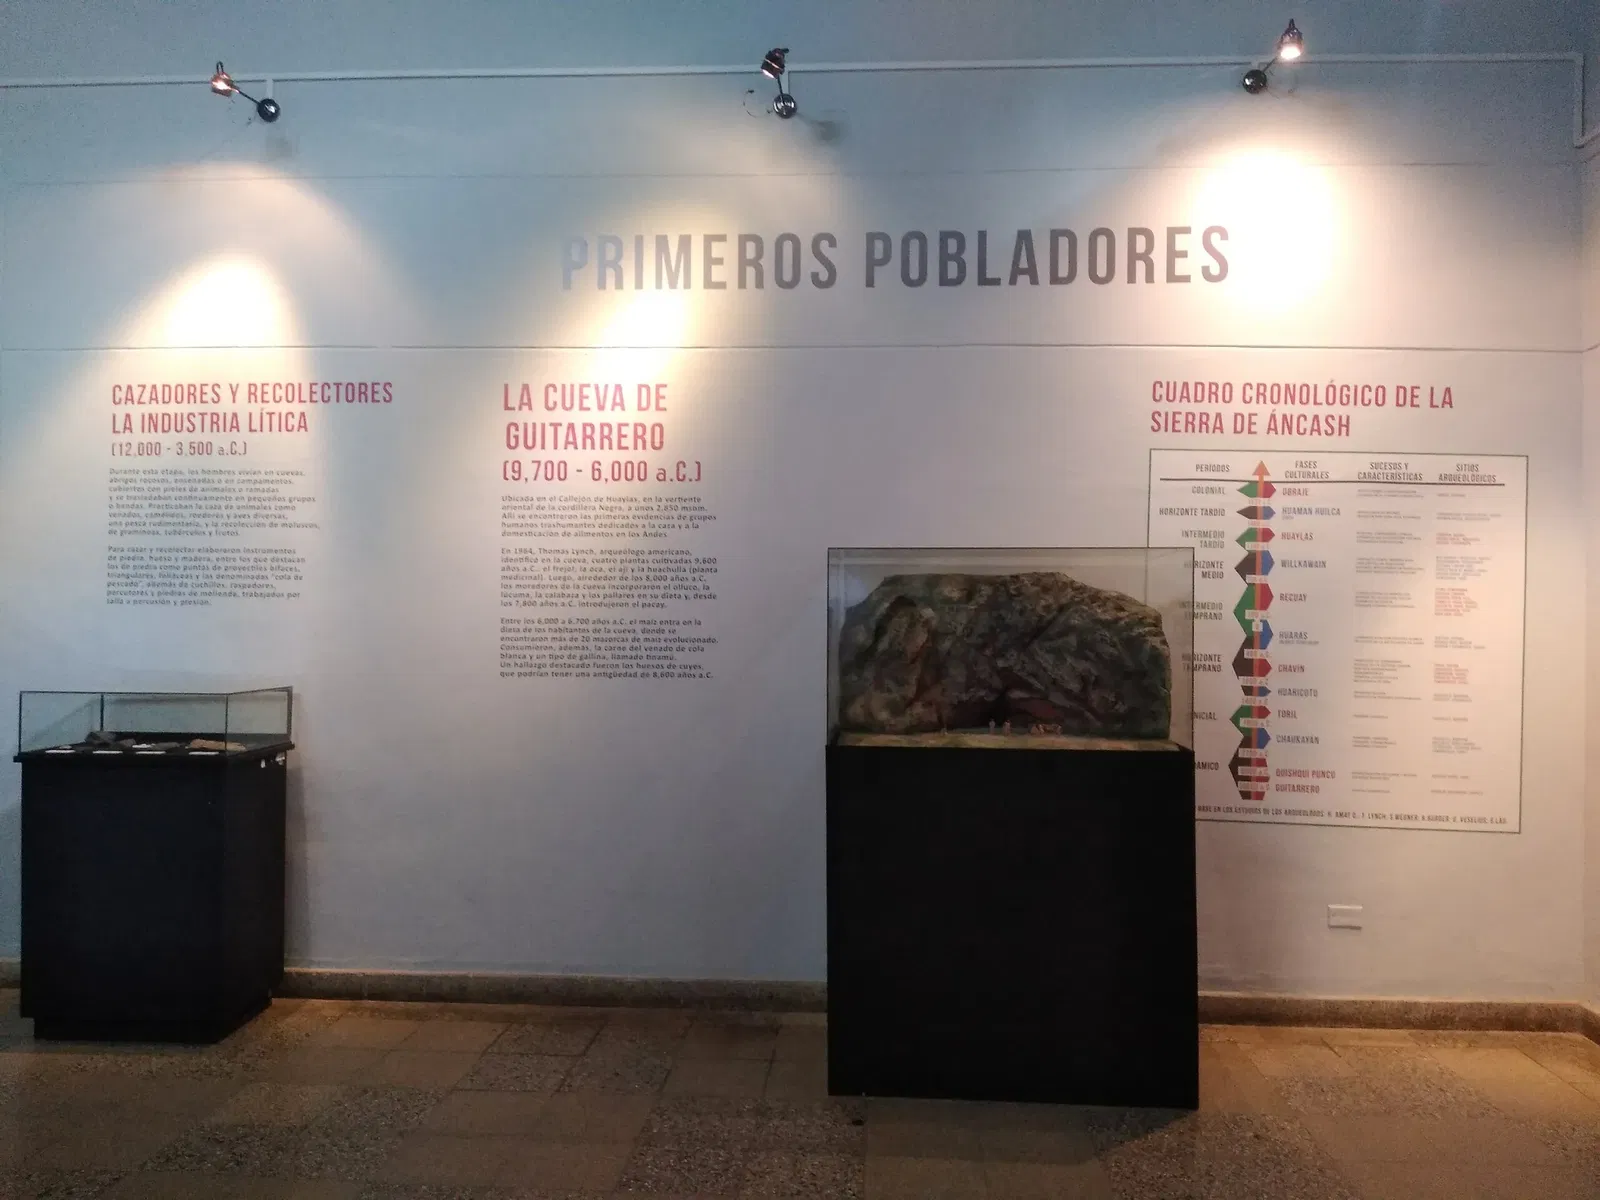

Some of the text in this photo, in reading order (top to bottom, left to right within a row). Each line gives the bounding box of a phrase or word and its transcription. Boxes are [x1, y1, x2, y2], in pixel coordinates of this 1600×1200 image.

[561, 225, 1230, 291] PRIMEROS POBLADORES
[112, 382, 393, 405] CAZADORES Y RECOLECTORES
[503, 383, 667, 412] LA CUEVA DE
[1152, 380, 1454, 409] CUADRO CRONOLÓGICO DE LA
[112, 408, 309, 434] LA INDUSTRIA LÍTICA
[1151, 407, 1351, 437] SIERRA DE ÁNCASH
[505, 422, 665, 451] GUITARRERO
[1295, 460, 1318, 469] FASES
[1369, 462, 1409, 471] SUCESOS Y
[1455, 464, 1479, 473] SITIOS
[591, 460, 648, 484] 6,000
[1284, 470, 1330, 480] CULTURALES
[1191, 486, 1226, 495] COLONIAL
[1282, 487, 1309, 497] OBRAJE
[1159, 507, 1198, 517] HORIZONTE
[1181, 530, 1225, 539] INTERMEDIO
[1281, 532, 1314, 541] HUAYLAS
[1201, 571, 1224, 580] MEDIO
[1279, 593, 1307, 602] RECUAY
[1279, 631, 1308, 640] HUARAS
[1191, 711, 1217, 721] NICIAL
[1277, 709, 1298, 719] TORIL
[1275, 784, 1320, 794] GUITARRERO
